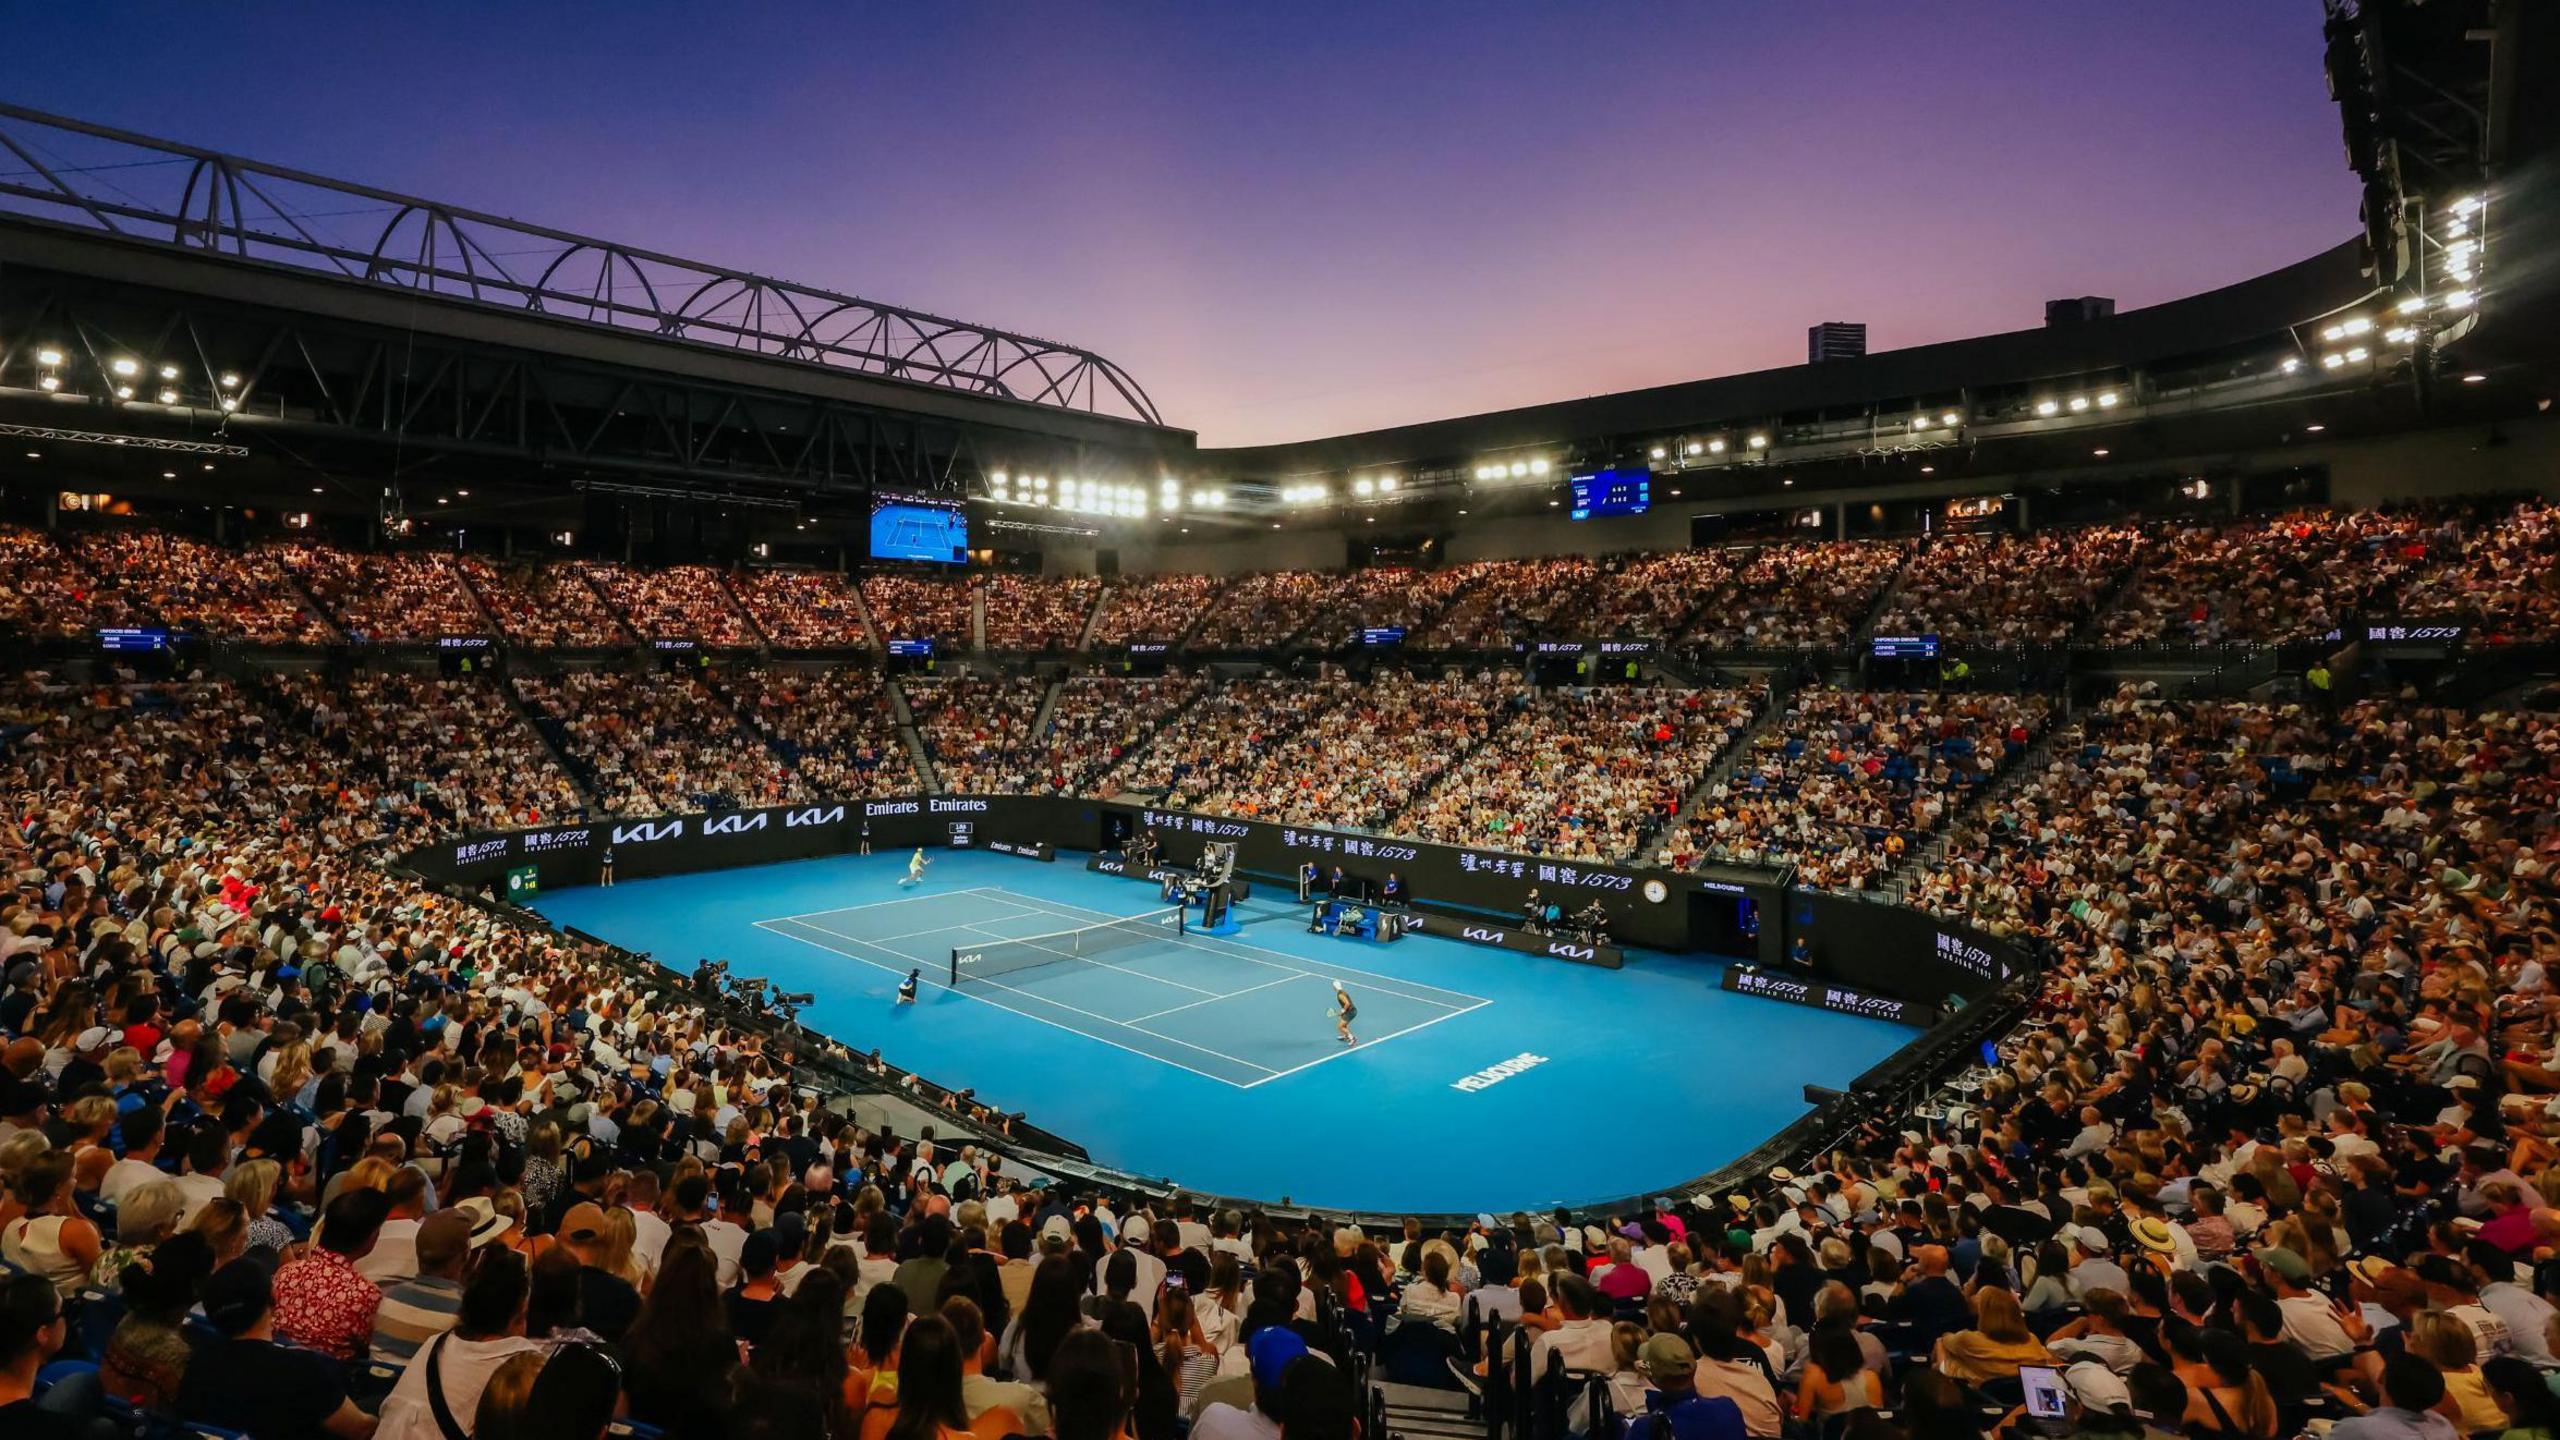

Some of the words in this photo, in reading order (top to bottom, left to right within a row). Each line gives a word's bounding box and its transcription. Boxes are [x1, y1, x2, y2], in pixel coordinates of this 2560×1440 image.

[866, 802, 919, 817] Emirates
[930, 798, 987, 812] Emirates
[613, 820, 683, 844] KIA
[704, 813, 767, 835] KIA
[786, 806, 844, 827] KIA
[1704, 882, 1744, 892] MELBOURNE
[1463, 927, 1504, 943] KIA
[1549, 942, 1594, 960] KIA
[1449, 1052, 1549, 1092] MELBOURNE
